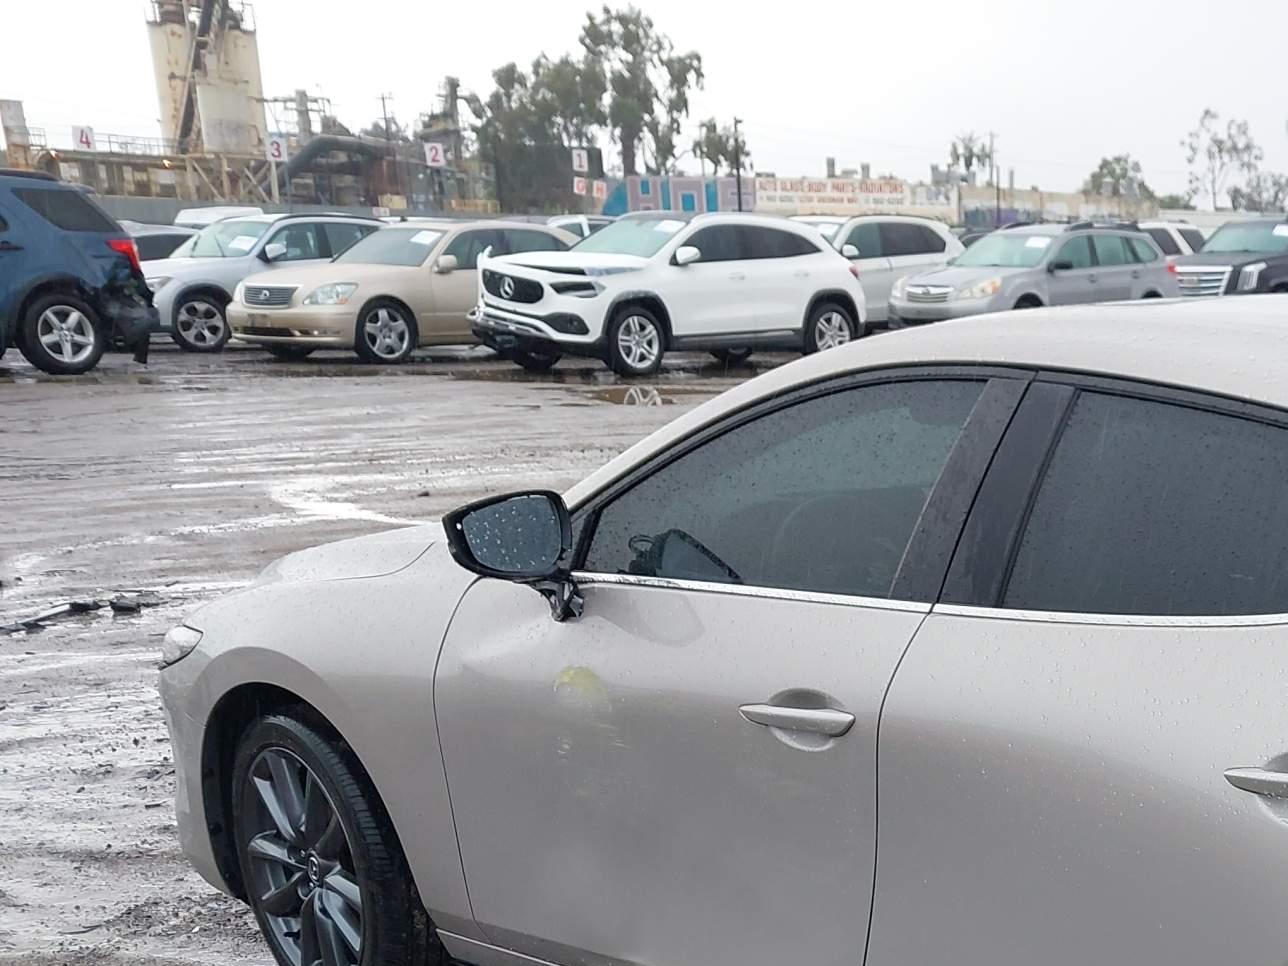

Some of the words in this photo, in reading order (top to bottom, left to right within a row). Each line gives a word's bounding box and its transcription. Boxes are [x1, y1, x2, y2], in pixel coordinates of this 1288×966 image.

[79, 129, 91, 149] 4
[271, 139, 281, 158] 3
[430, 147, 441, 163] 2
[577, 153, 585, 168] 1
